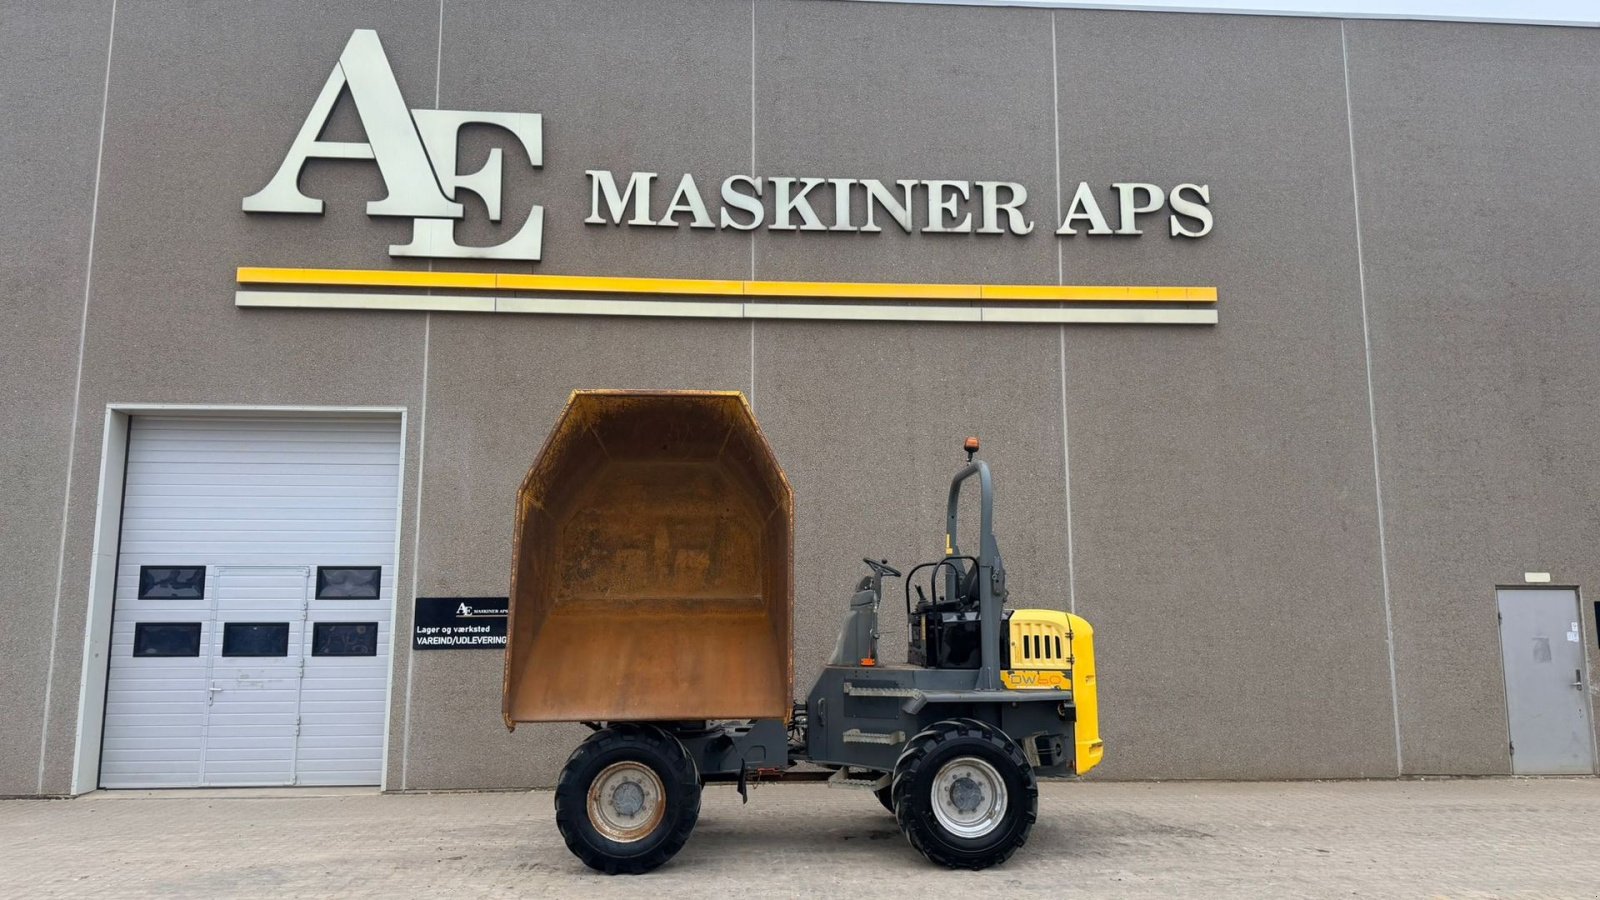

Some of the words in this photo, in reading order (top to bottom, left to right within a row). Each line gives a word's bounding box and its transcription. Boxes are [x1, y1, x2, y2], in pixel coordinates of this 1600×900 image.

[242, 28, 545, 261] AE
[584, 169, 1035, 236] MASKINER
[1055, 181, 1215, 239] APS
[456, 602, 473, 616] AE
[416, 625, 440, 635] Lager
[441, 626, 452, 635] og
[453, 625, 491, 633] værksted
[416, 636, 507, 646] VAREIND/UDLEVERING
[1010, 674, 1062, 685] DW60
